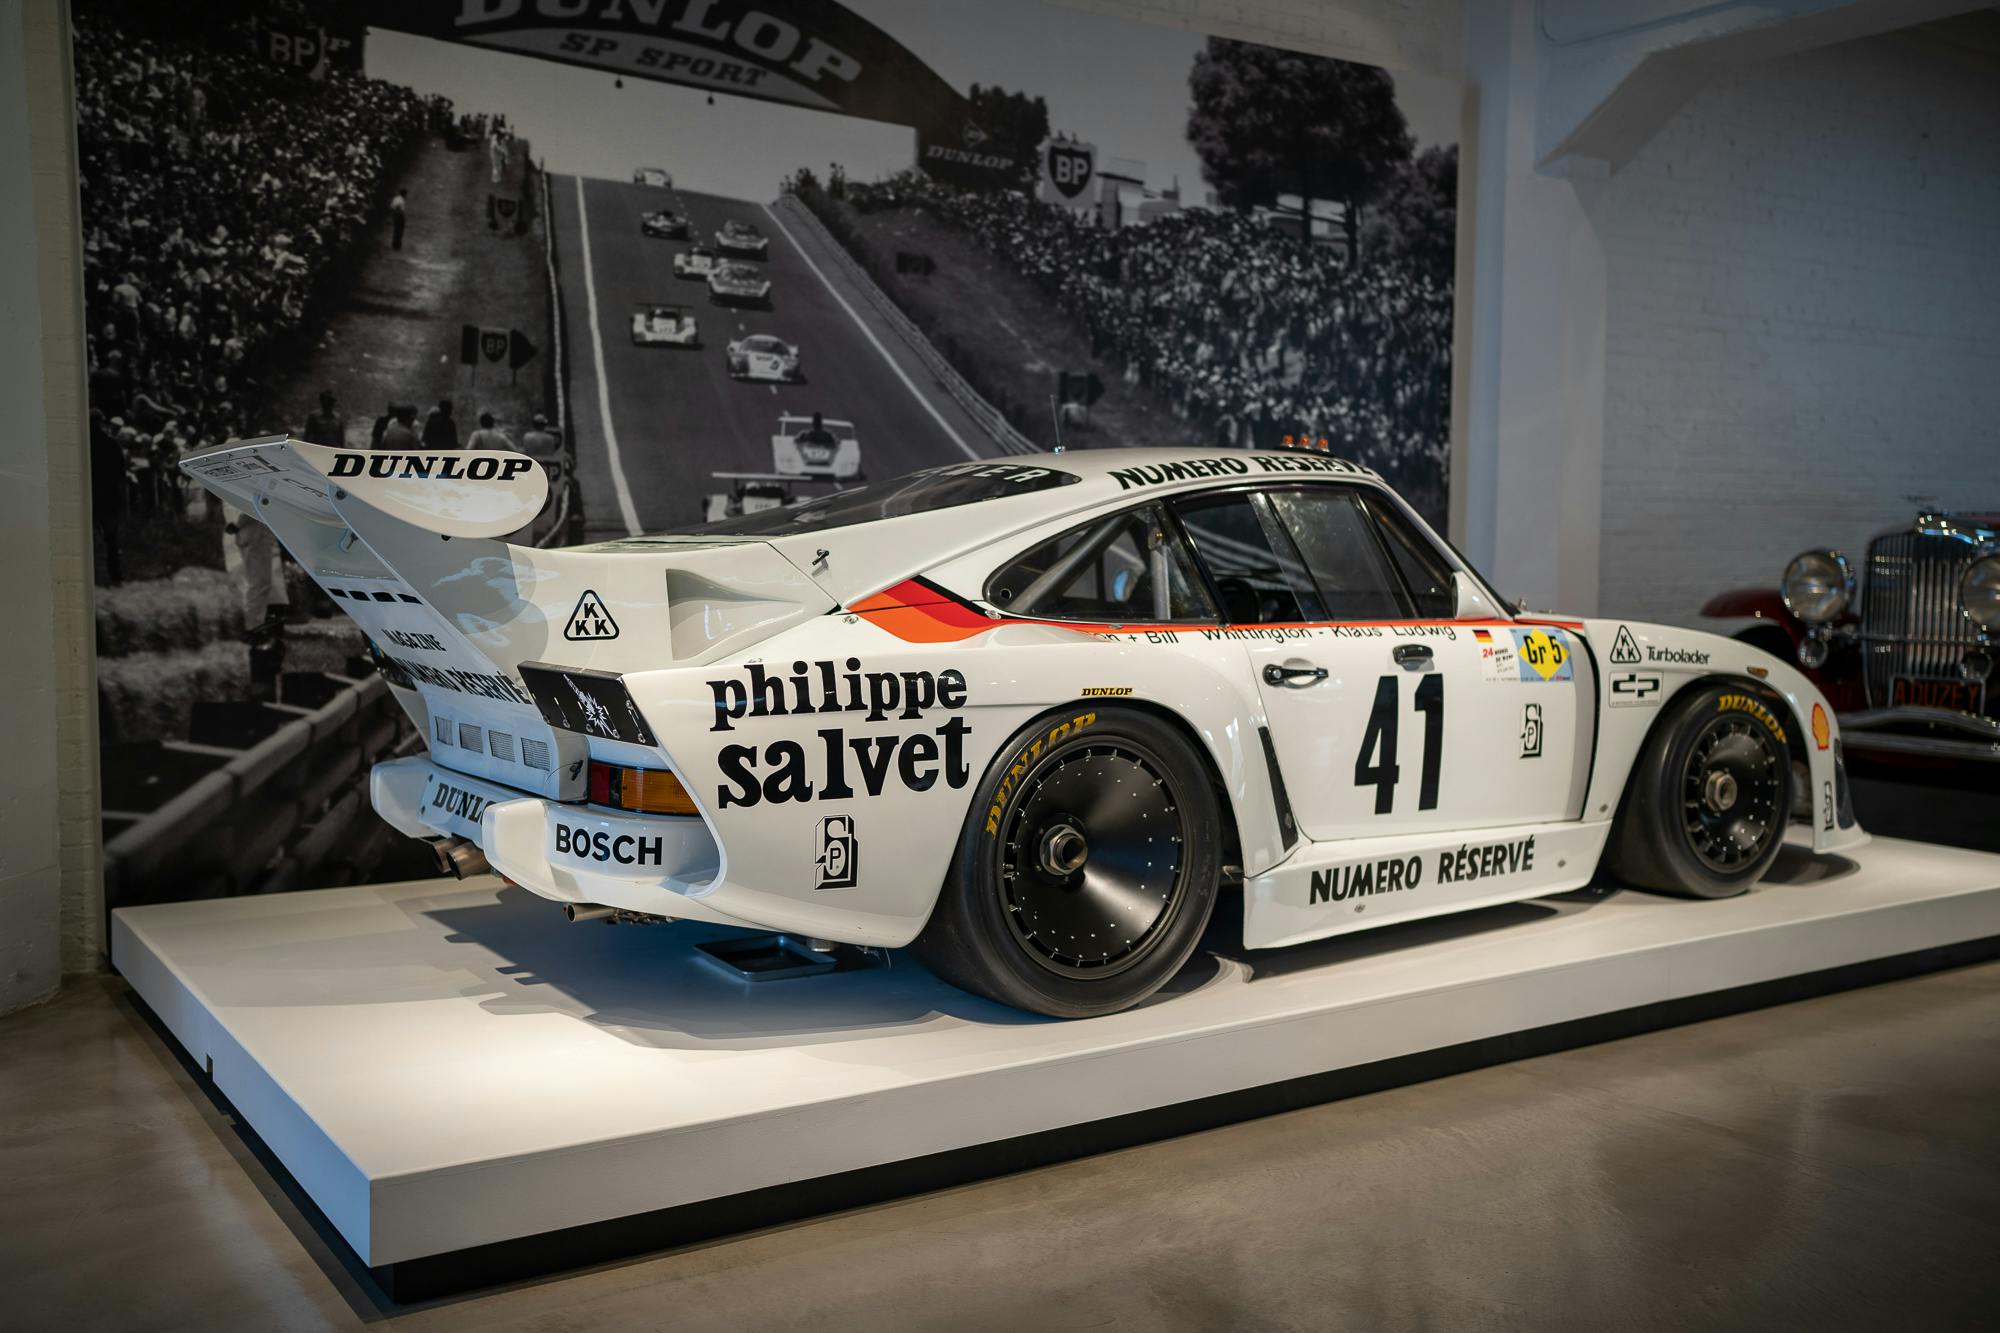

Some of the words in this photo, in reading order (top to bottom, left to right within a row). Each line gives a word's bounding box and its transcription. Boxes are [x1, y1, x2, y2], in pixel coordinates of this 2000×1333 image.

[269, 31, 316, 67] BP
[560, 31, 618, 57] SP
[635, 46, 768, 87] SPORT
[926, 145, 1015, 171] DUNLOP
[1054, 154, 1089, 185] BP
[328, 453, 533, 481] DUNLOP
[1106, 457, 1249, 491] NUMERO
[1144, 630, 1179, 644] Bill
[1199, 626, 1312, 644] Whittington
[1331, 625, 1382, 640] Klaus
[1392, 625, 1457, 641] Ludwig
[1547, 635, 1563, 664] 5
[1646, 645, 1710, 665] Turbolader
[706, 657, 968, 732] philippe
[1081, 687, 1133, 697] DUNLOP
[1718, 694, 1788, 745] DUNLOP
[1354, 672, 1444, 815] 41
[717, 716, 973, 810] salvet
[984, 711, 1097, 841] DUNLOP
[555, 823, 663, 866] BOSCH
[1309, 855, 1423, 905] NUMERO
[1437, 835, 1536, 885] RÉSERVÉ
